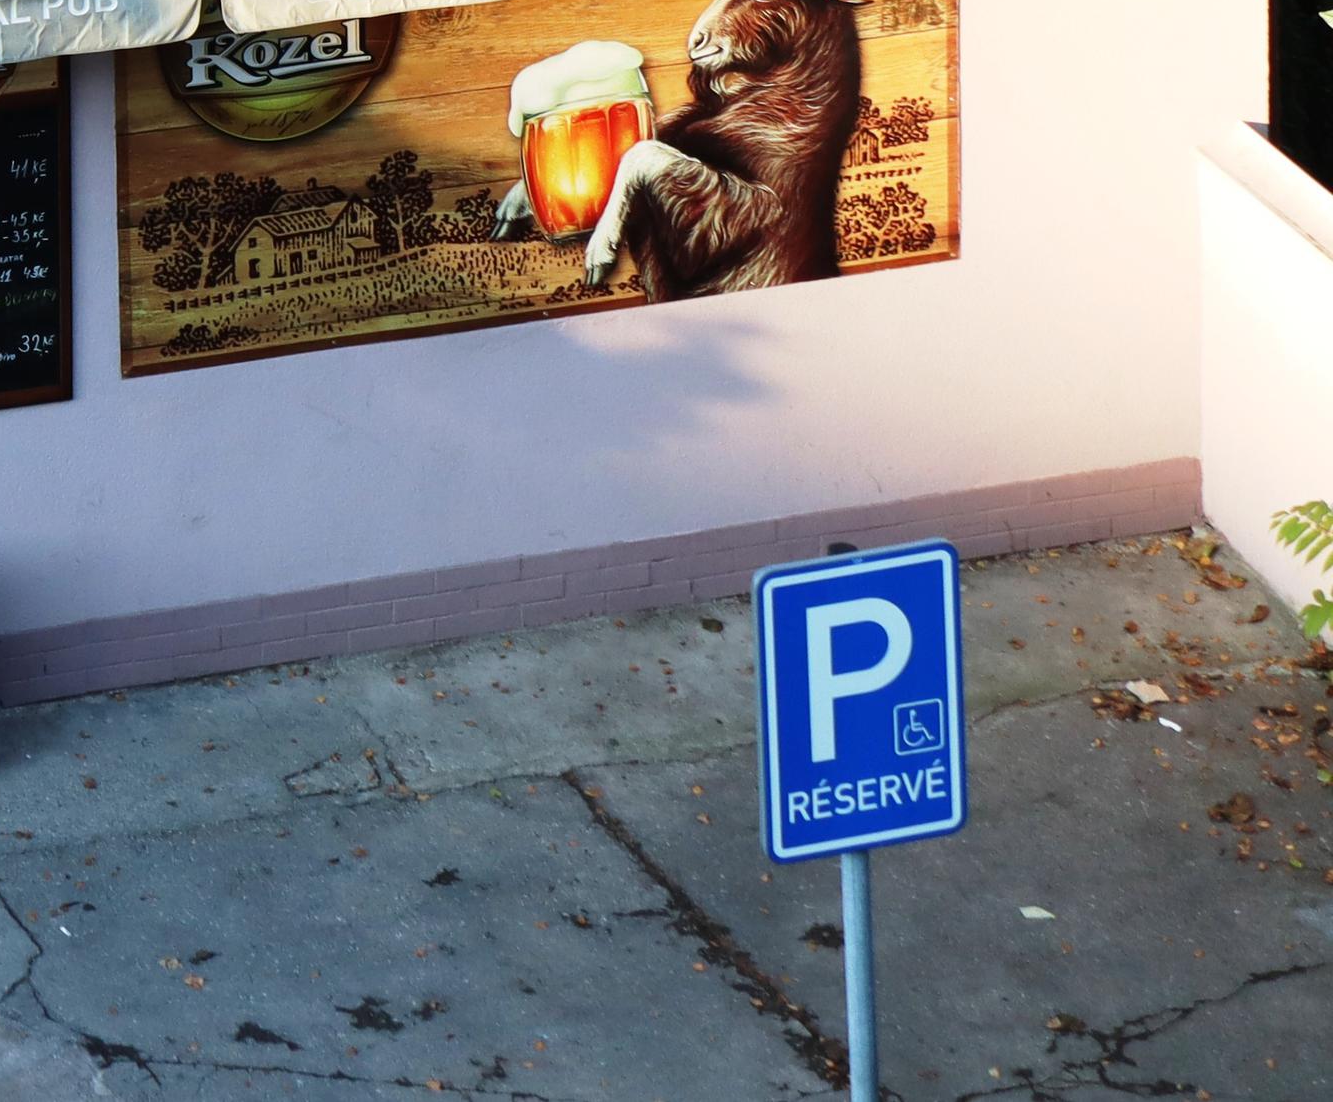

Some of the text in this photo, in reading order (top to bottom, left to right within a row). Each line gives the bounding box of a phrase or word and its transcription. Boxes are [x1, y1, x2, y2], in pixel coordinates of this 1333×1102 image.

[184, 18, 373, 90] Kozel
[10, 158, 28, 179] 41
[18, 334, 42, 353] 32
[806, 597, 913, 764] P
[788, 758, 948, 825] RÉSERVÉ
